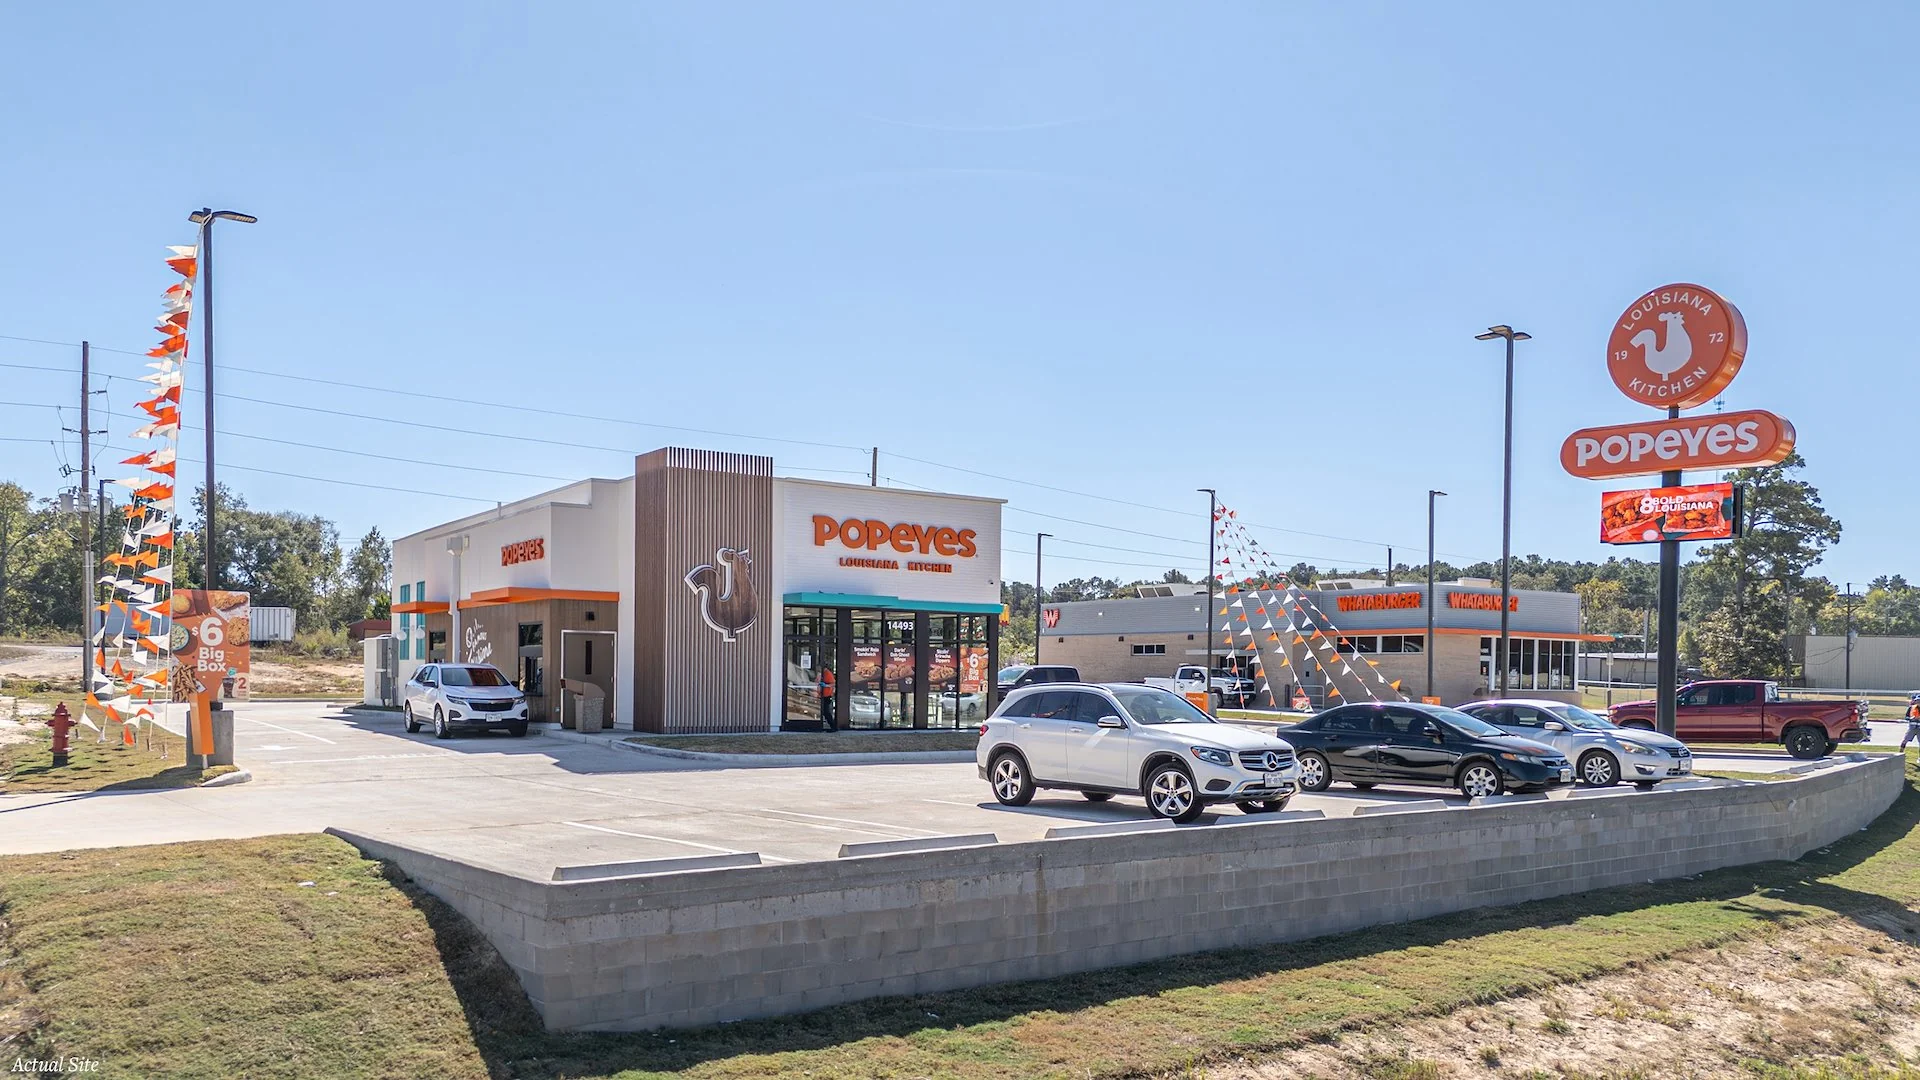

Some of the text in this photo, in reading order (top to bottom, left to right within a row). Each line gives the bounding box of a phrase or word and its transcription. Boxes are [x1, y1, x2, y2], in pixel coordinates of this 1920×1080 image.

[1622, 291, 1712, 331] LOUISIANA
[1614, 332, 1724, 361] 19 72
[1628, 366, 1707, 397] KITCHEN
[1639, 496, 1684, 514] 8 BOLD
[1654, 501, 1714, 513] LOUISIANA
[839, 557, 953, 573] LOUISIANA KITCHEN
[1336, 592, 1421, 612] WHATABURGER
[1449, 591, 1518, 612] WHATABURER
[887, 621, 913, 630] 14493
[1043, 608, 1060, 628] W
[191, 617, 224, 646] $6
[199, 647, 225, 662] Big
[197, 660, 226, 672] Box
[968, 667, 979, 676] Big
